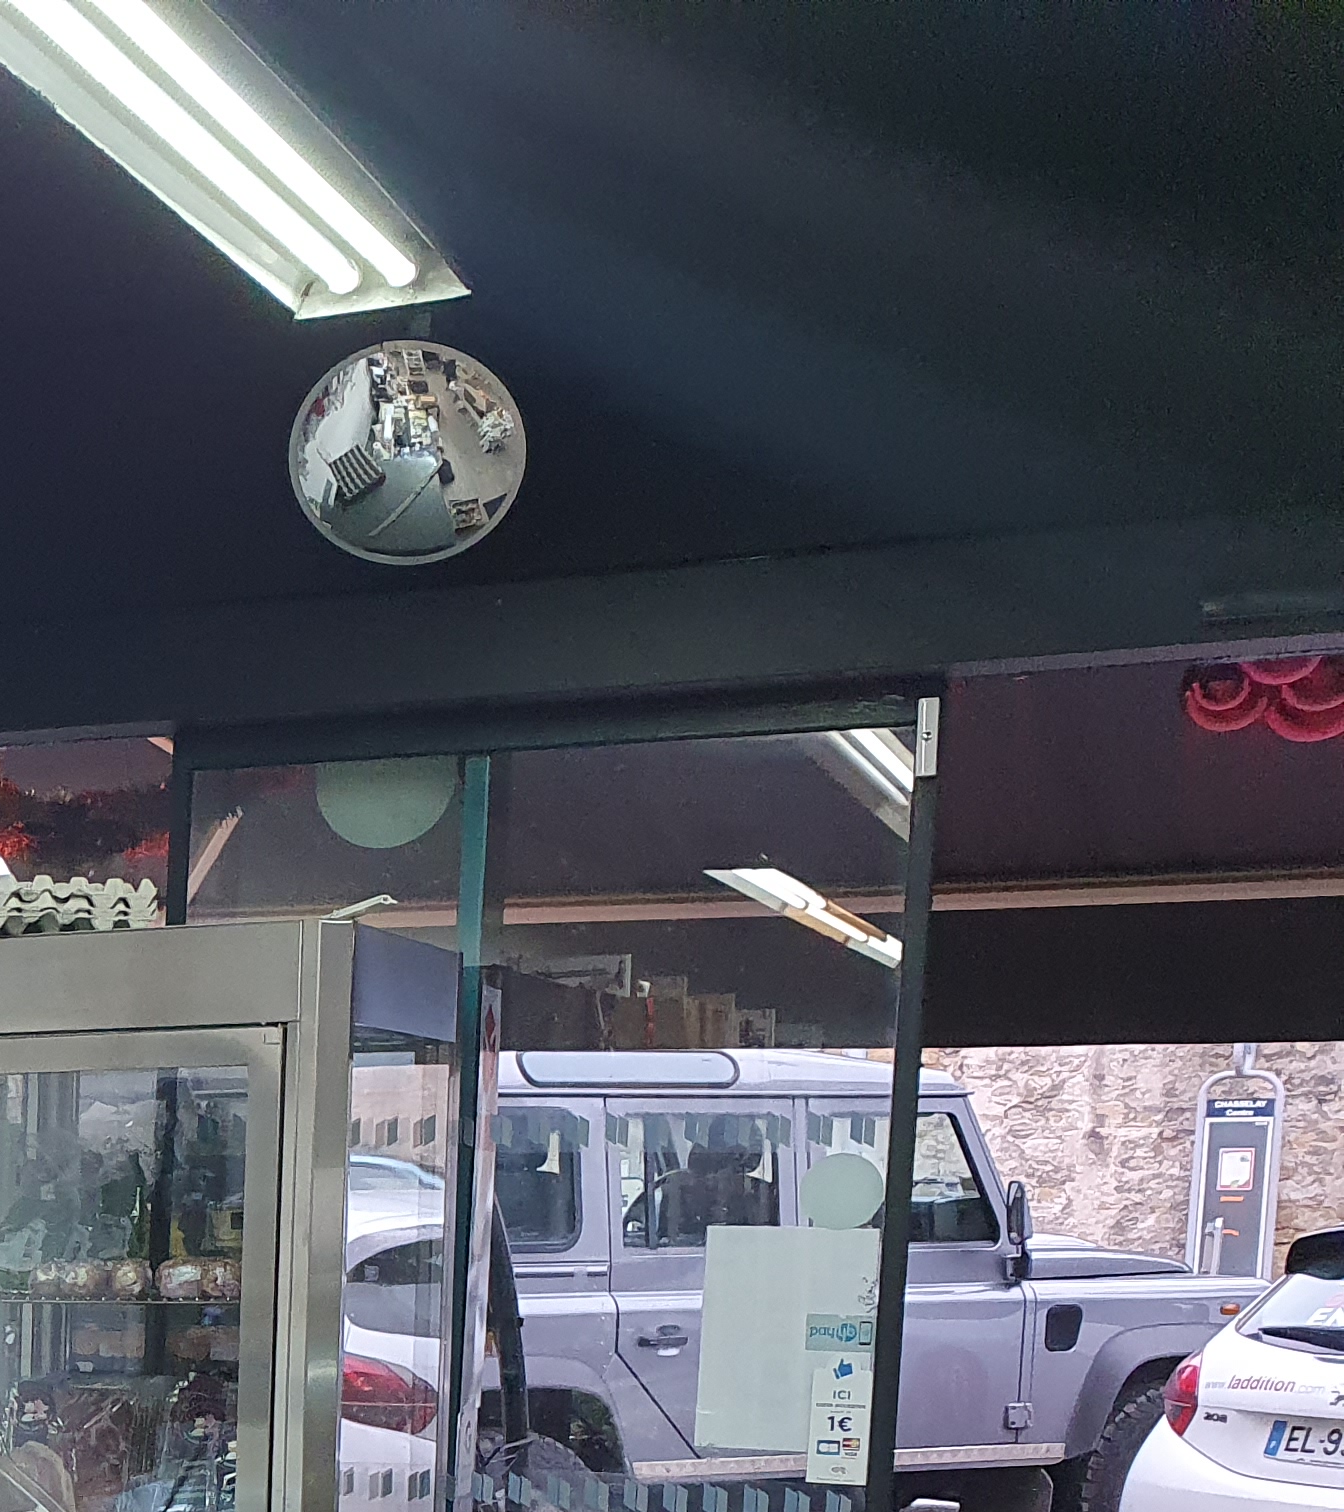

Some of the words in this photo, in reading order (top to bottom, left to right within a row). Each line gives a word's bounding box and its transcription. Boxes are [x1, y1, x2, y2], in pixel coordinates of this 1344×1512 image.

[1214, 1100, 1268, 1109] CHASSELAY
[832, 1389, 851, 1401] ICI
[1203, 1411, 1228, 1424] 208
[827, 1415, 853, 1433] 1€
